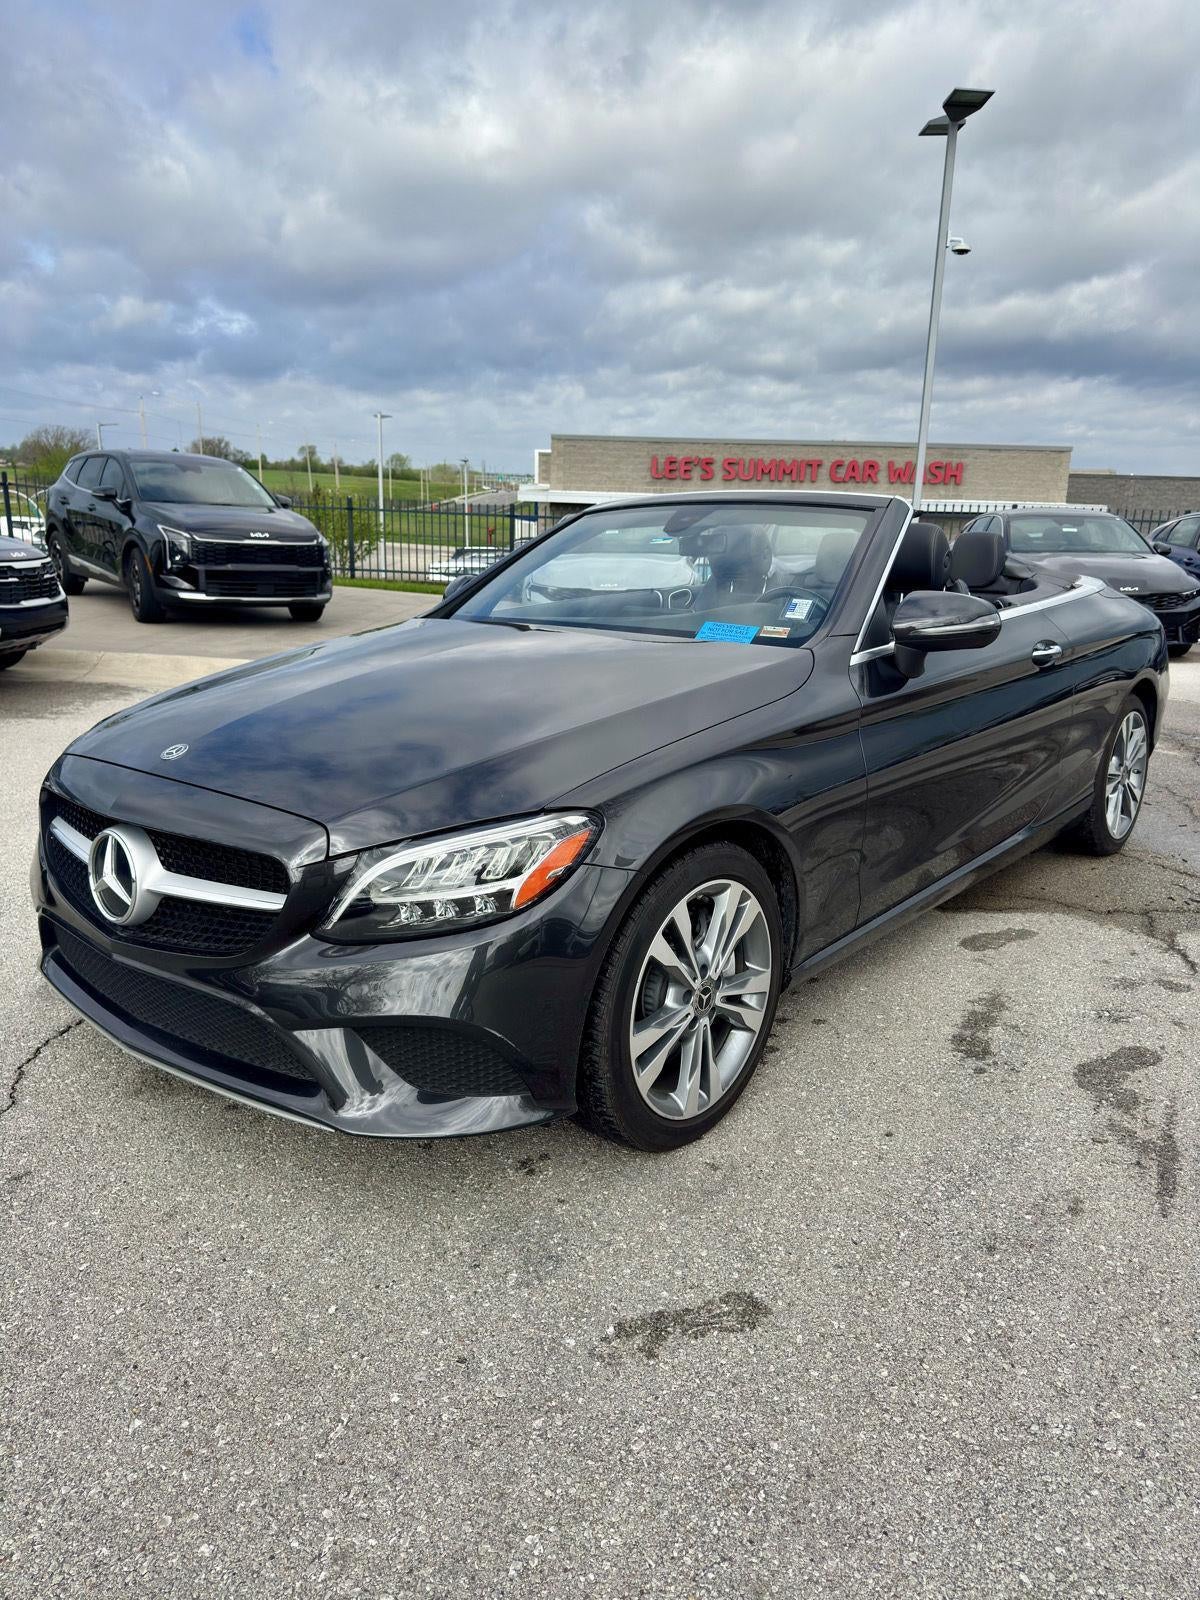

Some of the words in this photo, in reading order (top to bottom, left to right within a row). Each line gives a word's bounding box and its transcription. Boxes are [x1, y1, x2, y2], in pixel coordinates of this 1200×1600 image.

[650, 455, 715, 480] LEE'S
[721, 457, 823, 483] SUMMIT
[829, 459, 880, 484] CAR
